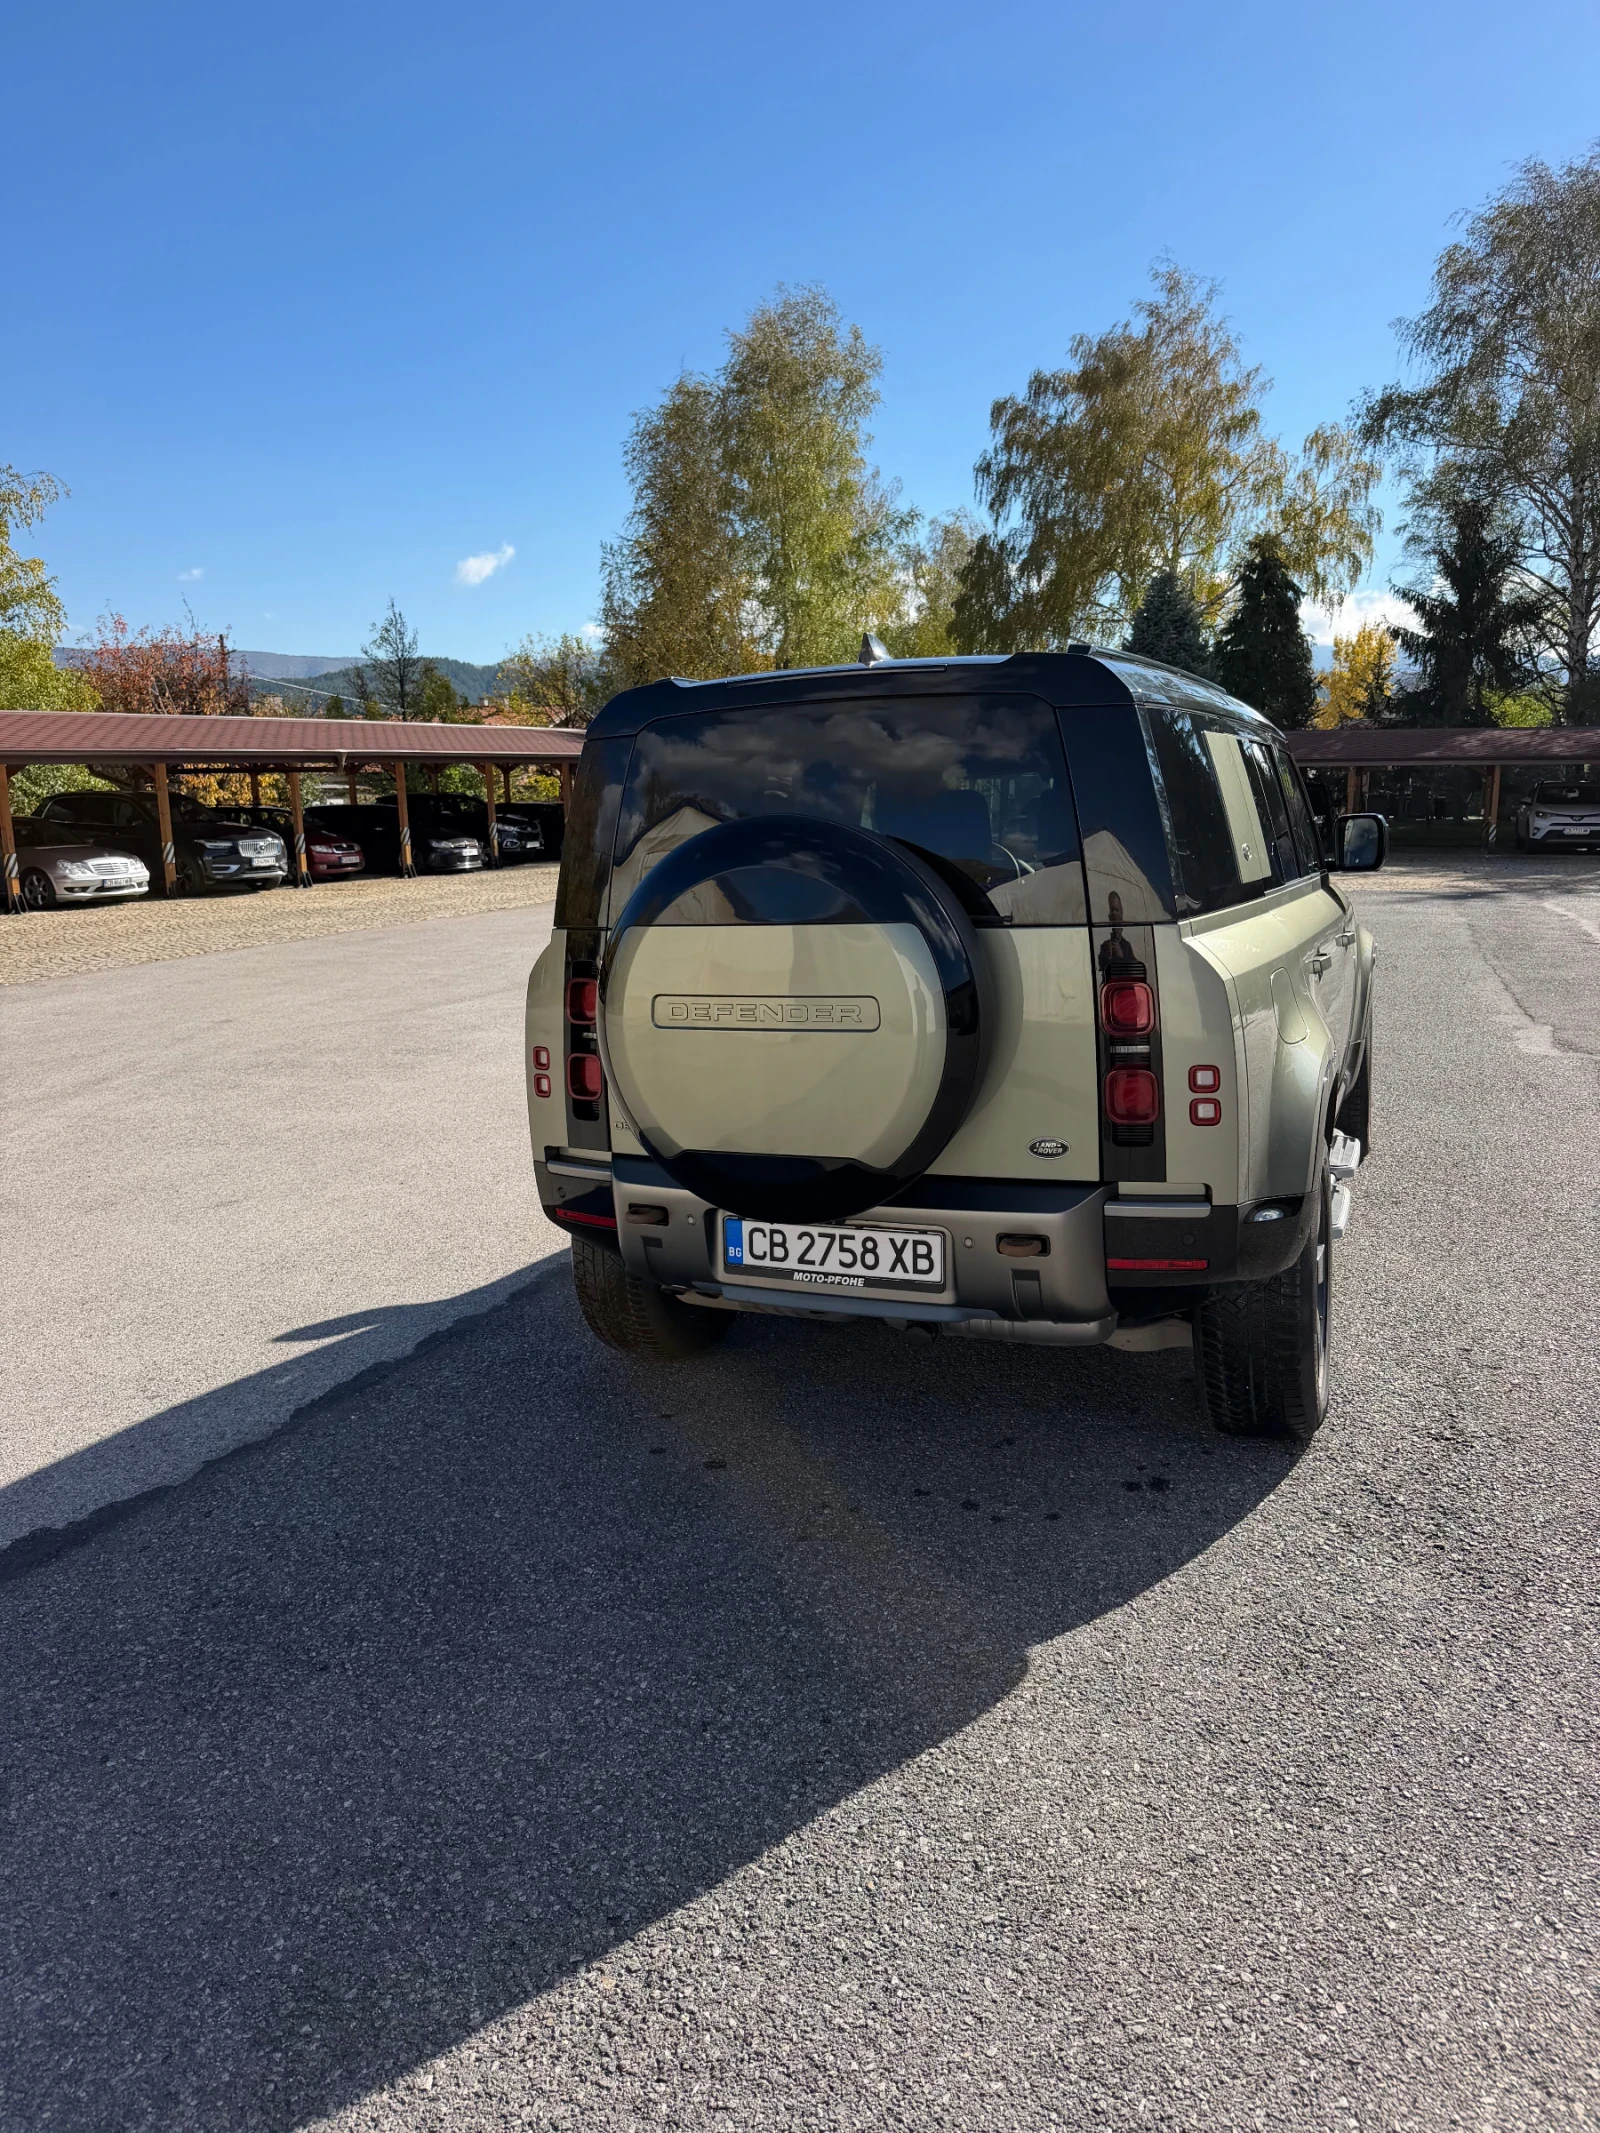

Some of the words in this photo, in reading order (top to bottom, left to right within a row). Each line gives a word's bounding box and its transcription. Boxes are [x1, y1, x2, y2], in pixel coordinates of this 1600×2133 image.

[667, 1002, 863, 1023] DEFENDER
[728, 1246, 742, 1257] BG
[748, 1227, 789, 1263] CB
[796, 1231, 880, 1271] 2758
[888, 1237, 935, 1275] XB
[793, 1271, 865, 1287] MOTO-PFOHE
